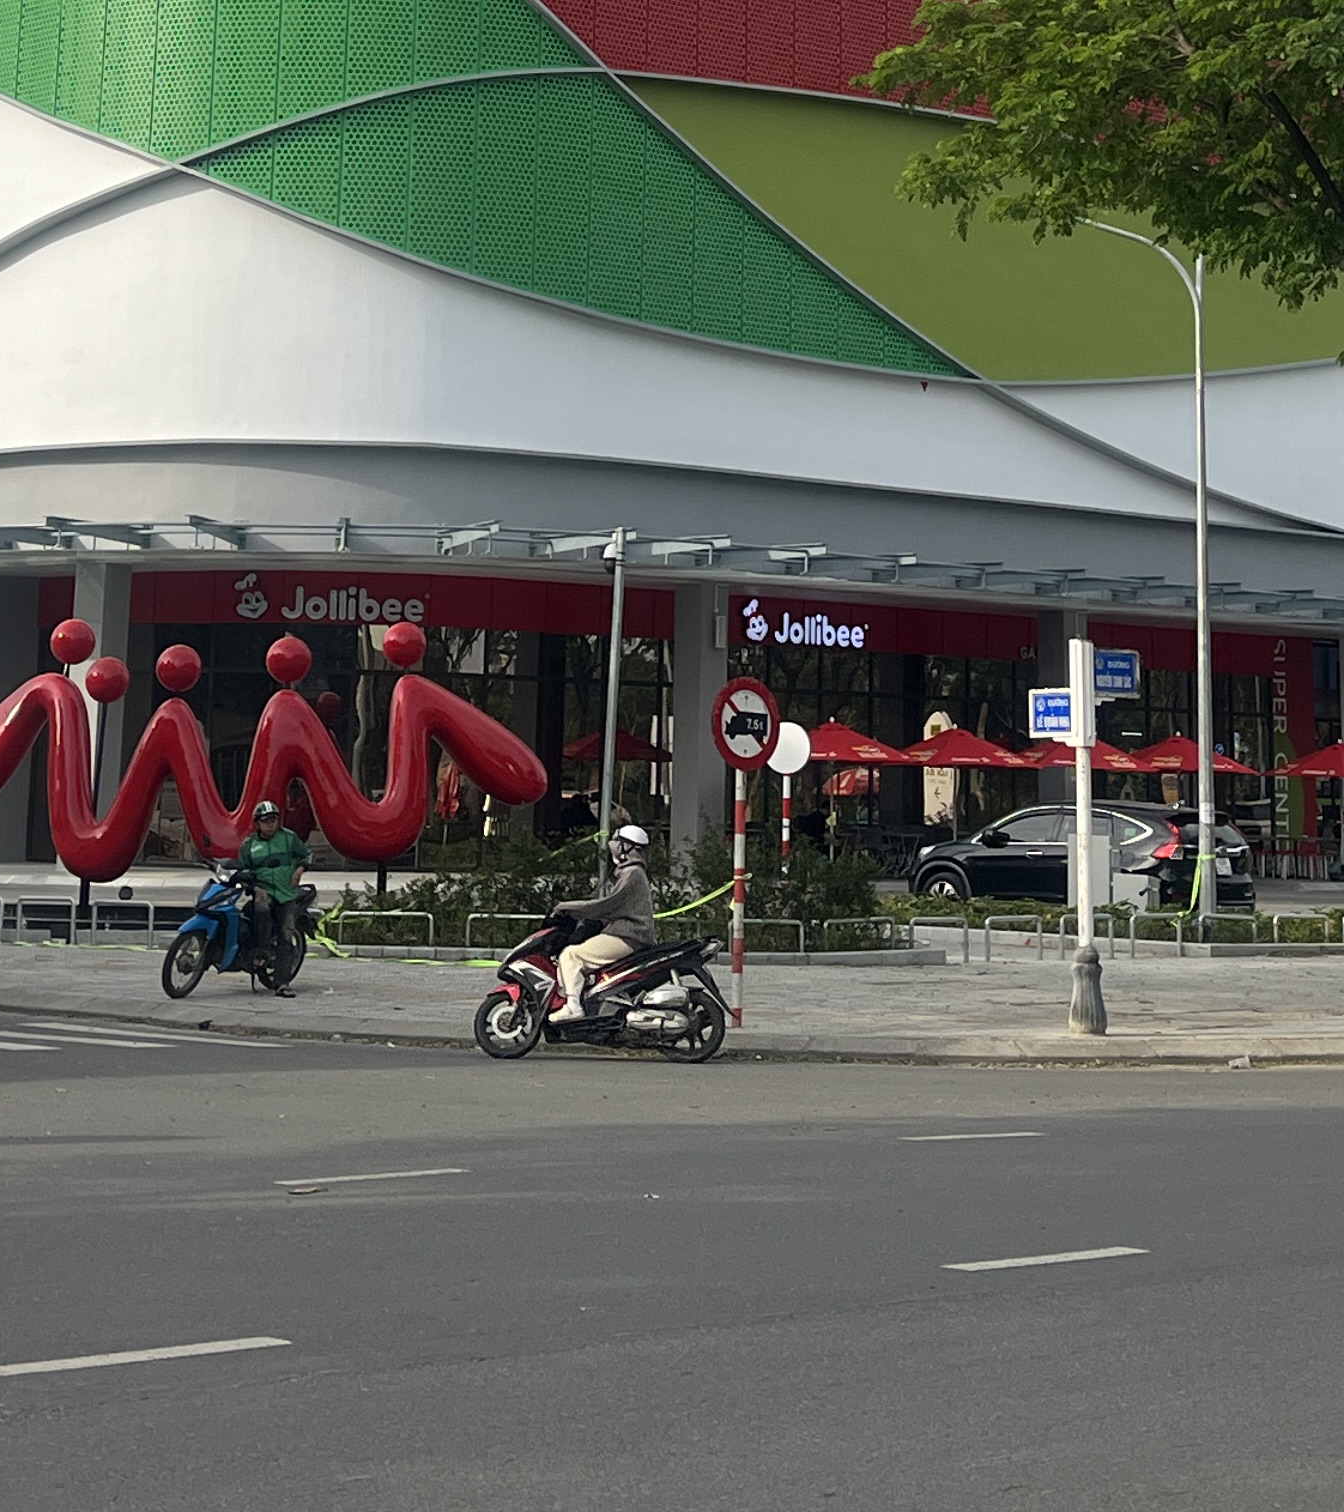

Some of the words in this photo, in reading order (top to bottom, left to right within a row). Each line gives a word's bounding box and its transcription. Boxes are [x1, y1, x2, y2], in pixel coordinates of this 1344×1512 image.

[281, 586, 425, 622] Jollibee
[774, 611, 865, 648] Jollibee
[1273, 639, 1287, 734] SUPER
[1274, 752, 1290, 852] CENTE
